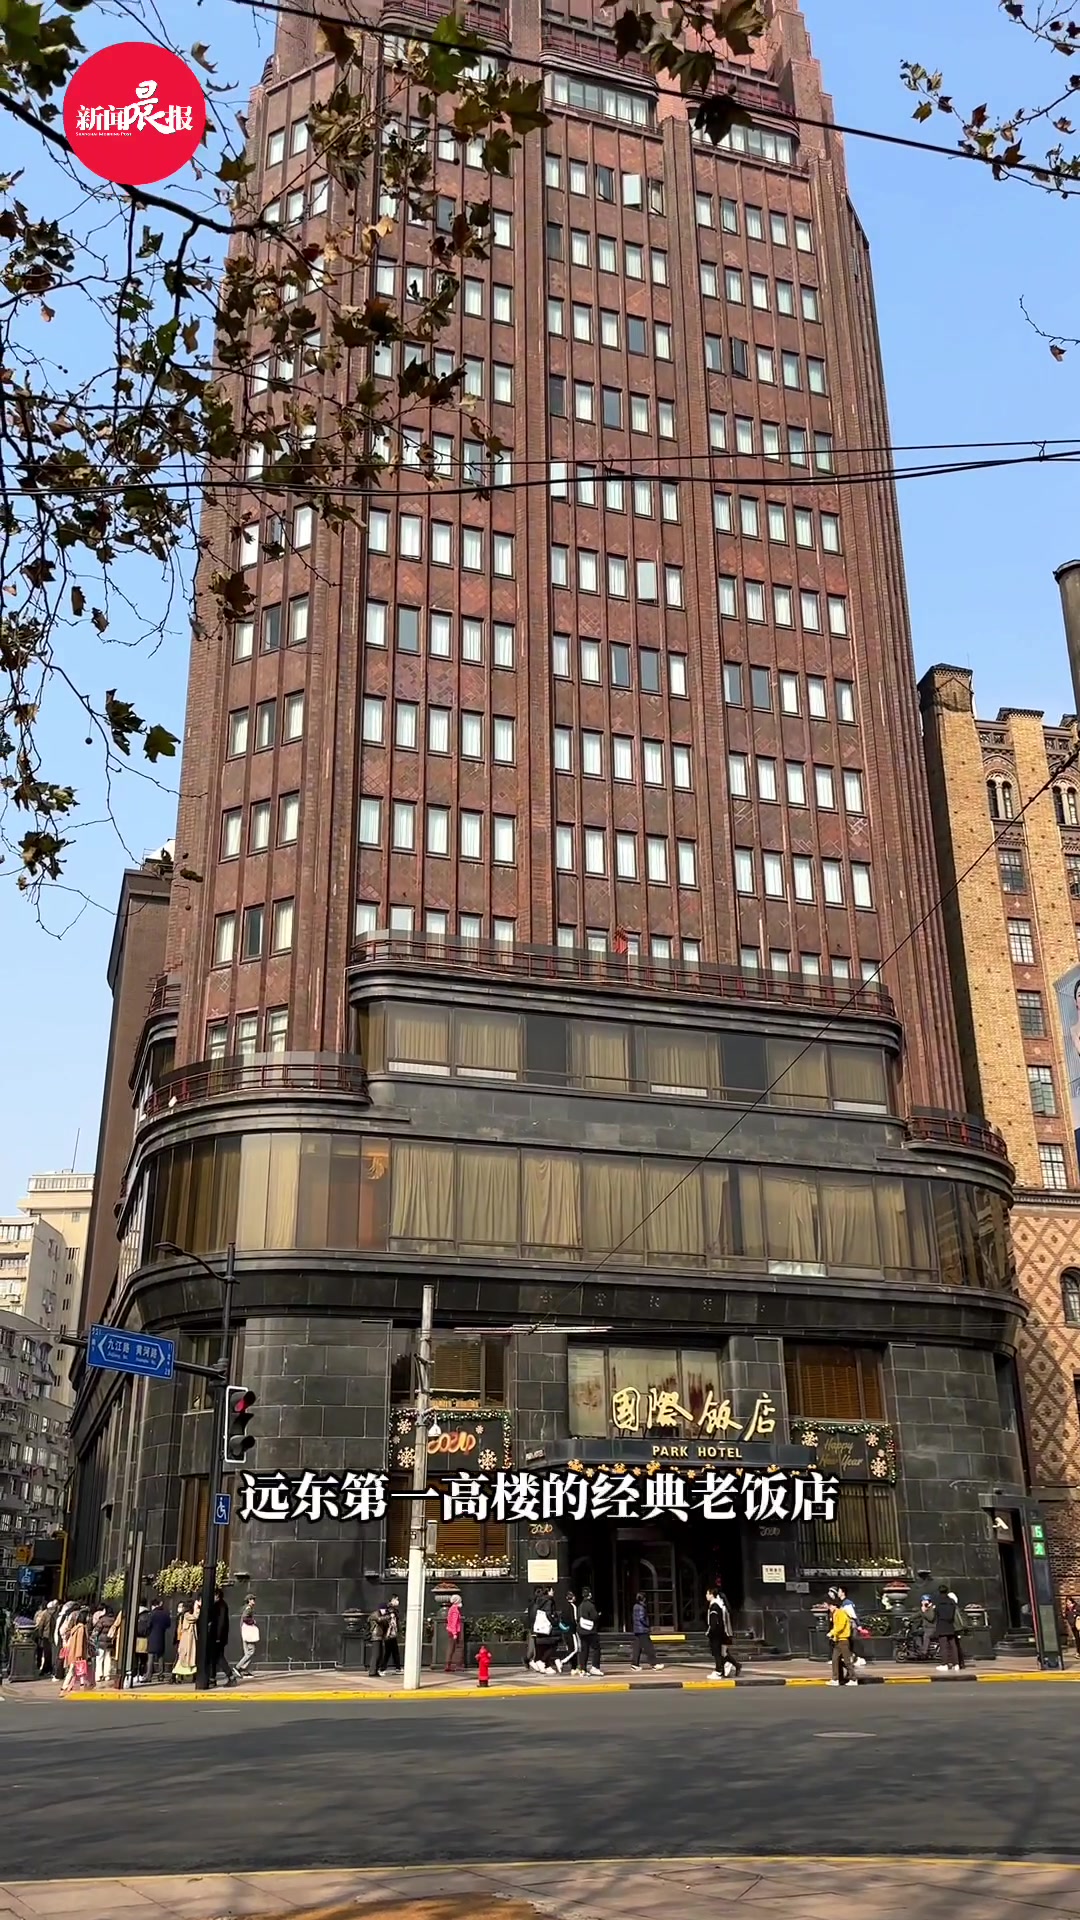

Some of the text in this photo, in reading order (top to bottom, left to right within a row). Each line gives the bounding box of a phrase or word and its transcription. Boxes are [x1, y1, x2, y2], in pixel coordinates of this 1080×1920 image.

[107, 1339, 130, 1354] 九江路
[652, 1445, 743, 1458] PARK HOTEL
